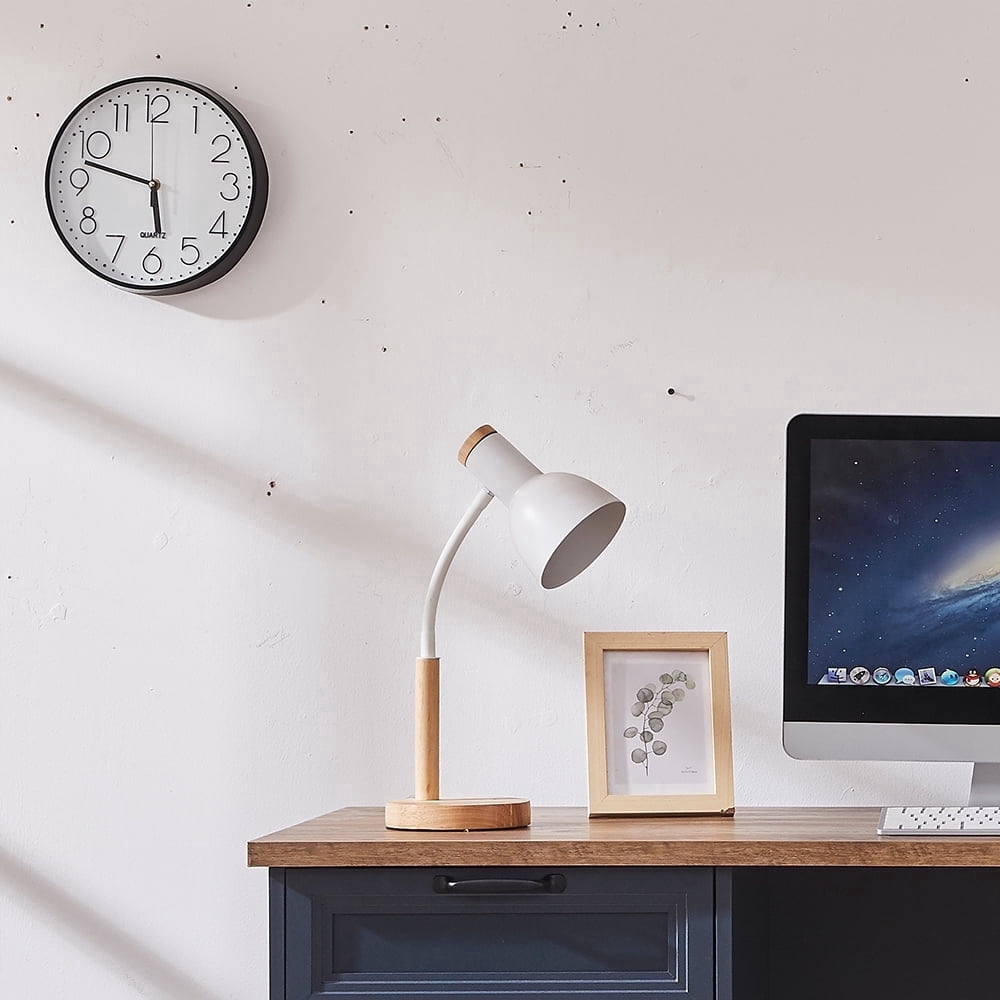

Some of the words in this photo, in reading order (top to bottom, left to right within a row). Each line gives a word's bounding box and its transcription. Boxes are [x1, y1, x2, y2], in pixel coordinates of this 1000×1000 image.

[113, 103, 129, 132] 11
[145, 94, 171, 123] 12
[192, 105, 198, 134] 1
[79, 130, 112, 159] 10
[211, 134, 232, 163] 2
[69, 168, 90, 196] 9
[220, 172, 240, 201] 3
[79, 206, 97, 235] 8
[139, 231, 167, 239] QUARTZ
[208, 210, 229, 239] 4
[105, 234, 125, 263] 7
[142, 246, 162, 275] 6
[180, 237, 200, 266] 5
